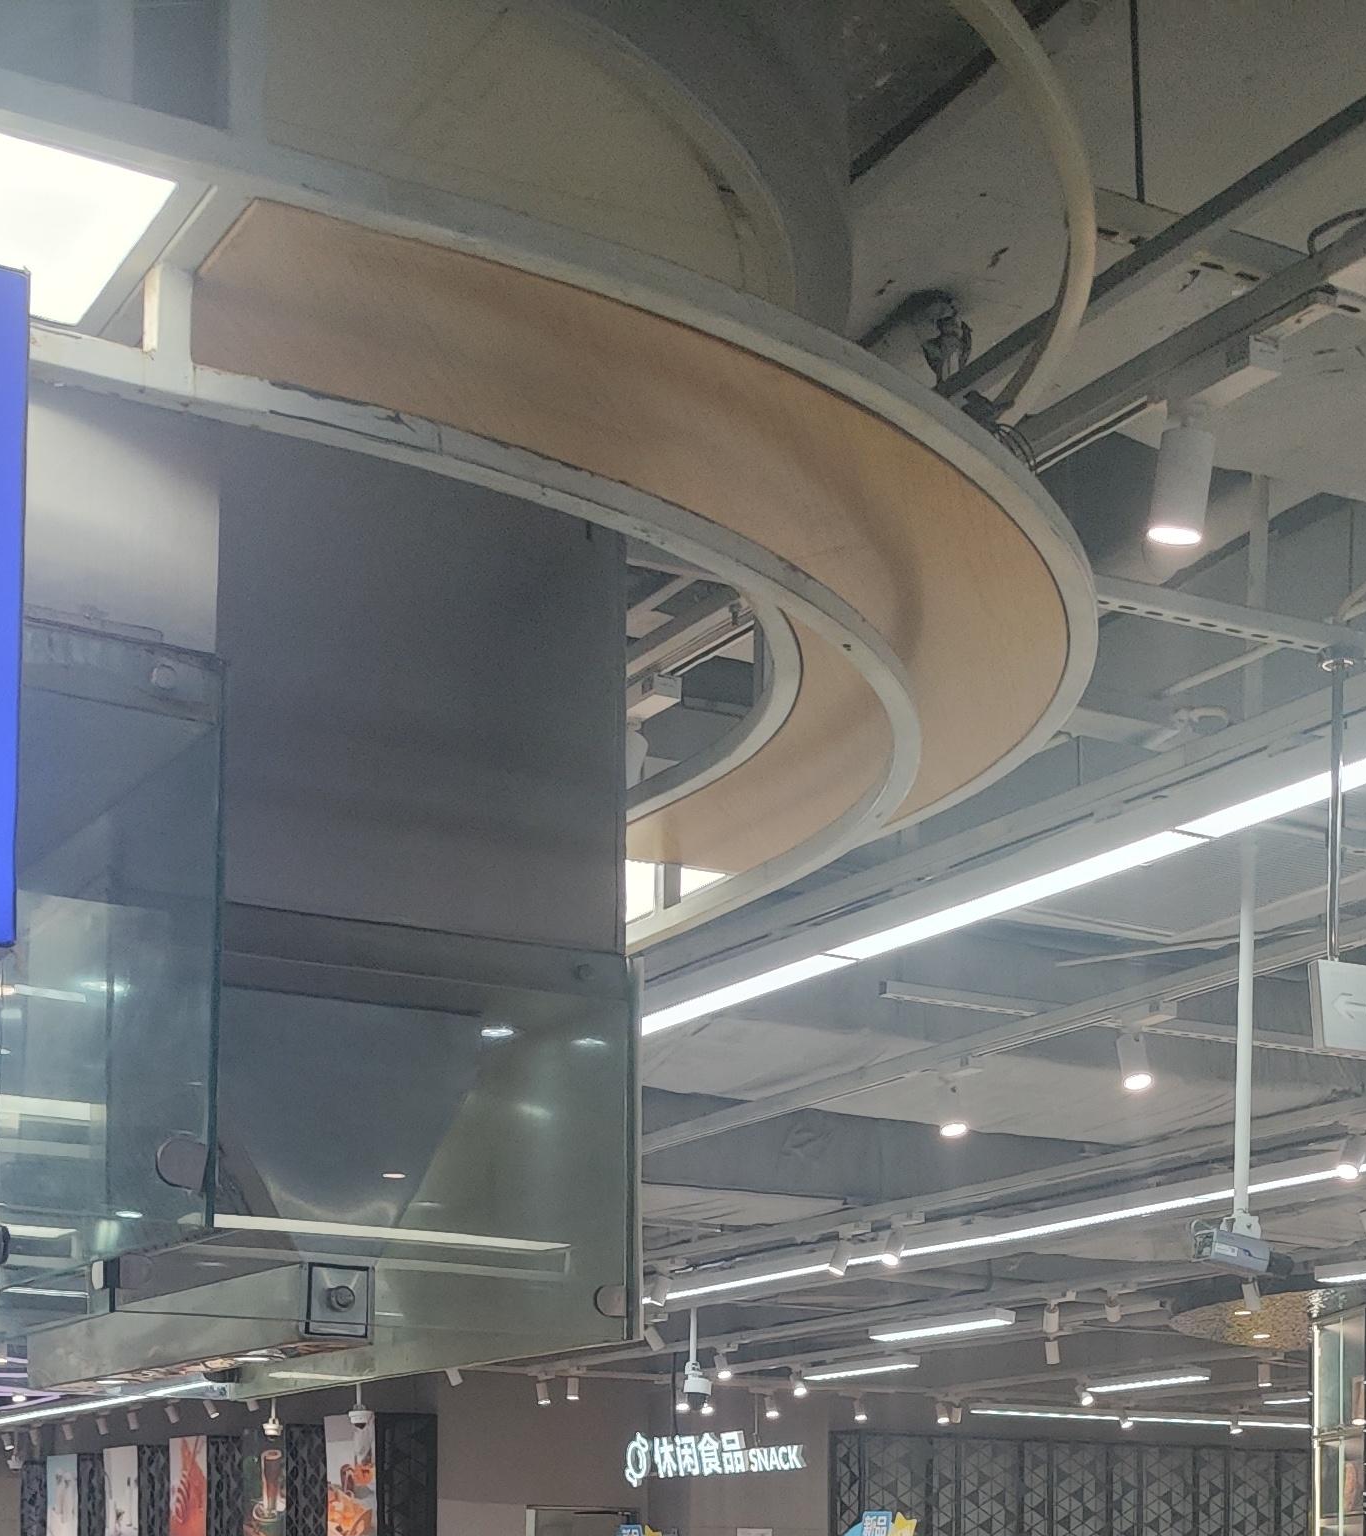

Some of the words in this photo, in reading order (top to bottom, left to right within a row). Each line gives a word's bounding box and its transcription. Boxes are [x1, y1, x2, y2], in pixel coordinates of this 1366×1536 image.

[653, 1431, 749, 1479] 休闲食品
[749, 1445, 804, 1473] SNACK
